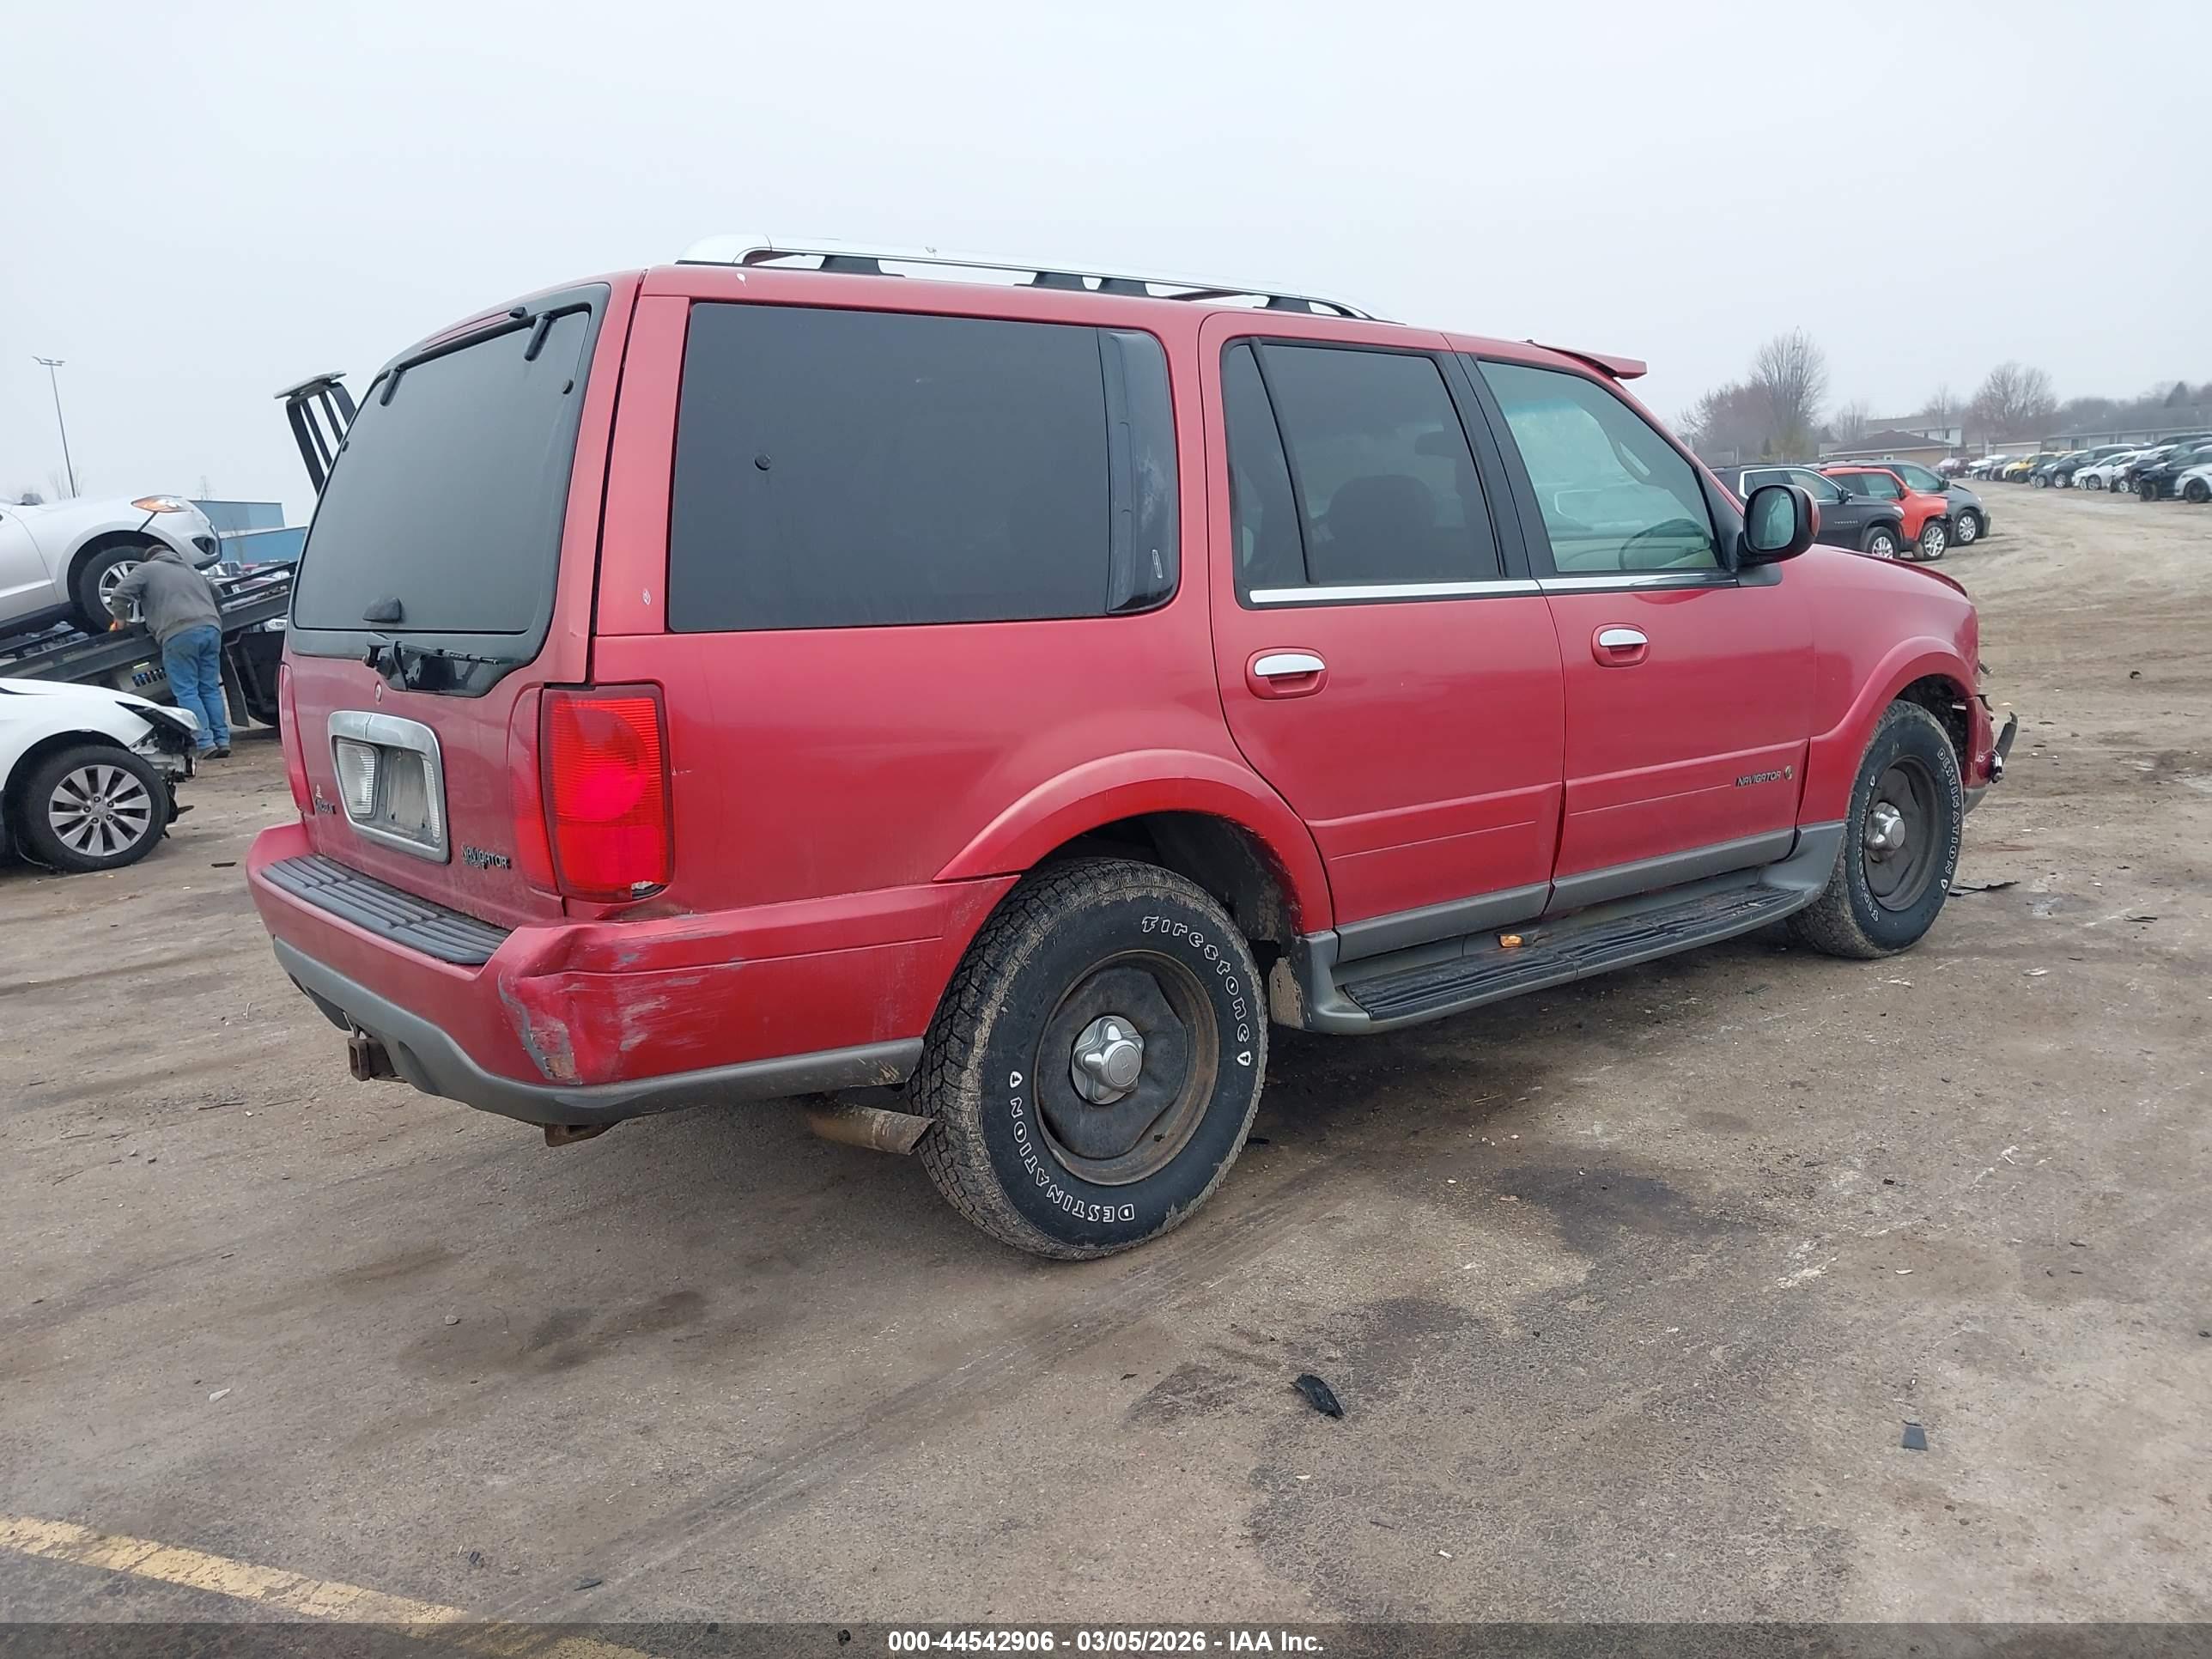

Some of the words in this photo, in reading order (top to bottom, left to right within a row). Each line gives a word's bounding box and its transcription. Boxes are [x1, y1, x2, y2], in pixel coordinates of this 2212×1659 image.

[1735, 770, 1782, 788] NAVIGATOR
[1937, 747, 1960, 875] DESTINATION
[460, 844, 510, 870] NAVIGATOR
[1141, 915, 1250, 1042] Firestone
[1010, 1097, 1135, 1223] DESTINATION
